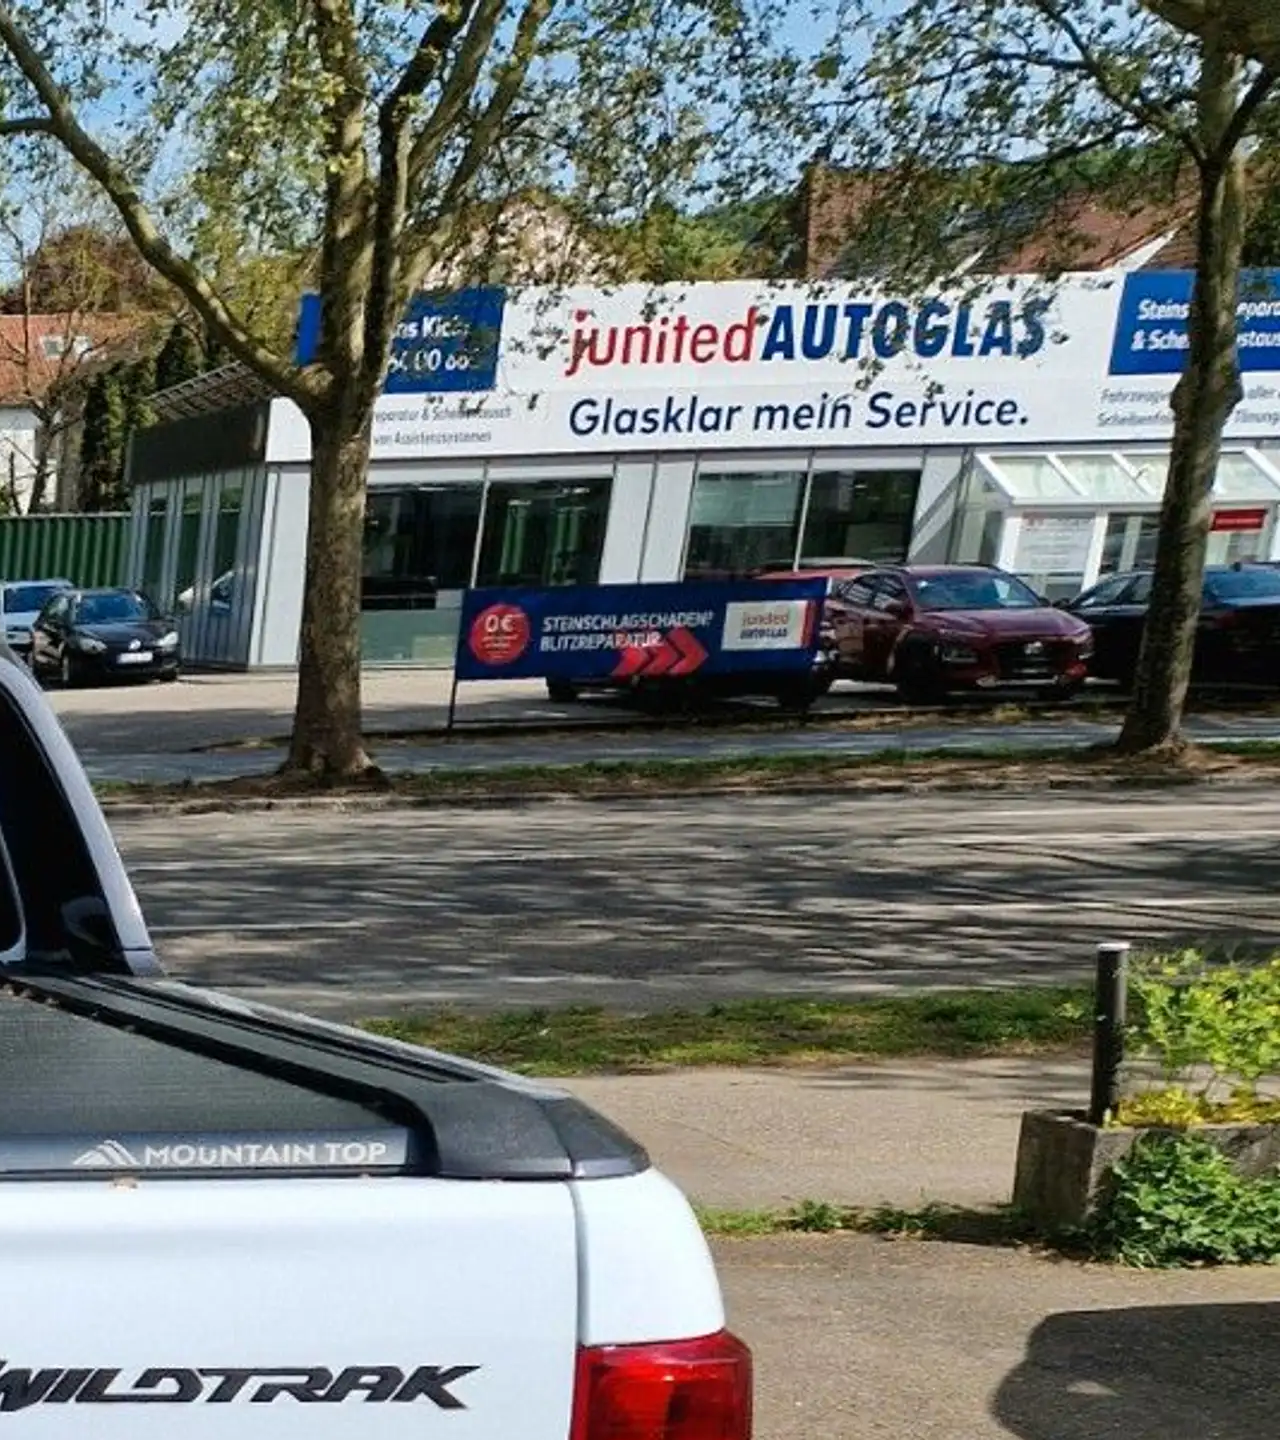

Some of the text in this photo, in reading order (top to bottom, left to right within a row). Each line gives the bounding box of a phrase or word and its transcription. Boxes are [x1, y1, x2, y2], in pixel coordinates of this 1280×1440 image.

[1131, 329, 1145, 350] &
[569, 392, 1029, 436] Glasklar mein Service.
[144, 1142, 387, 1165] MOUNTAIN TOP
